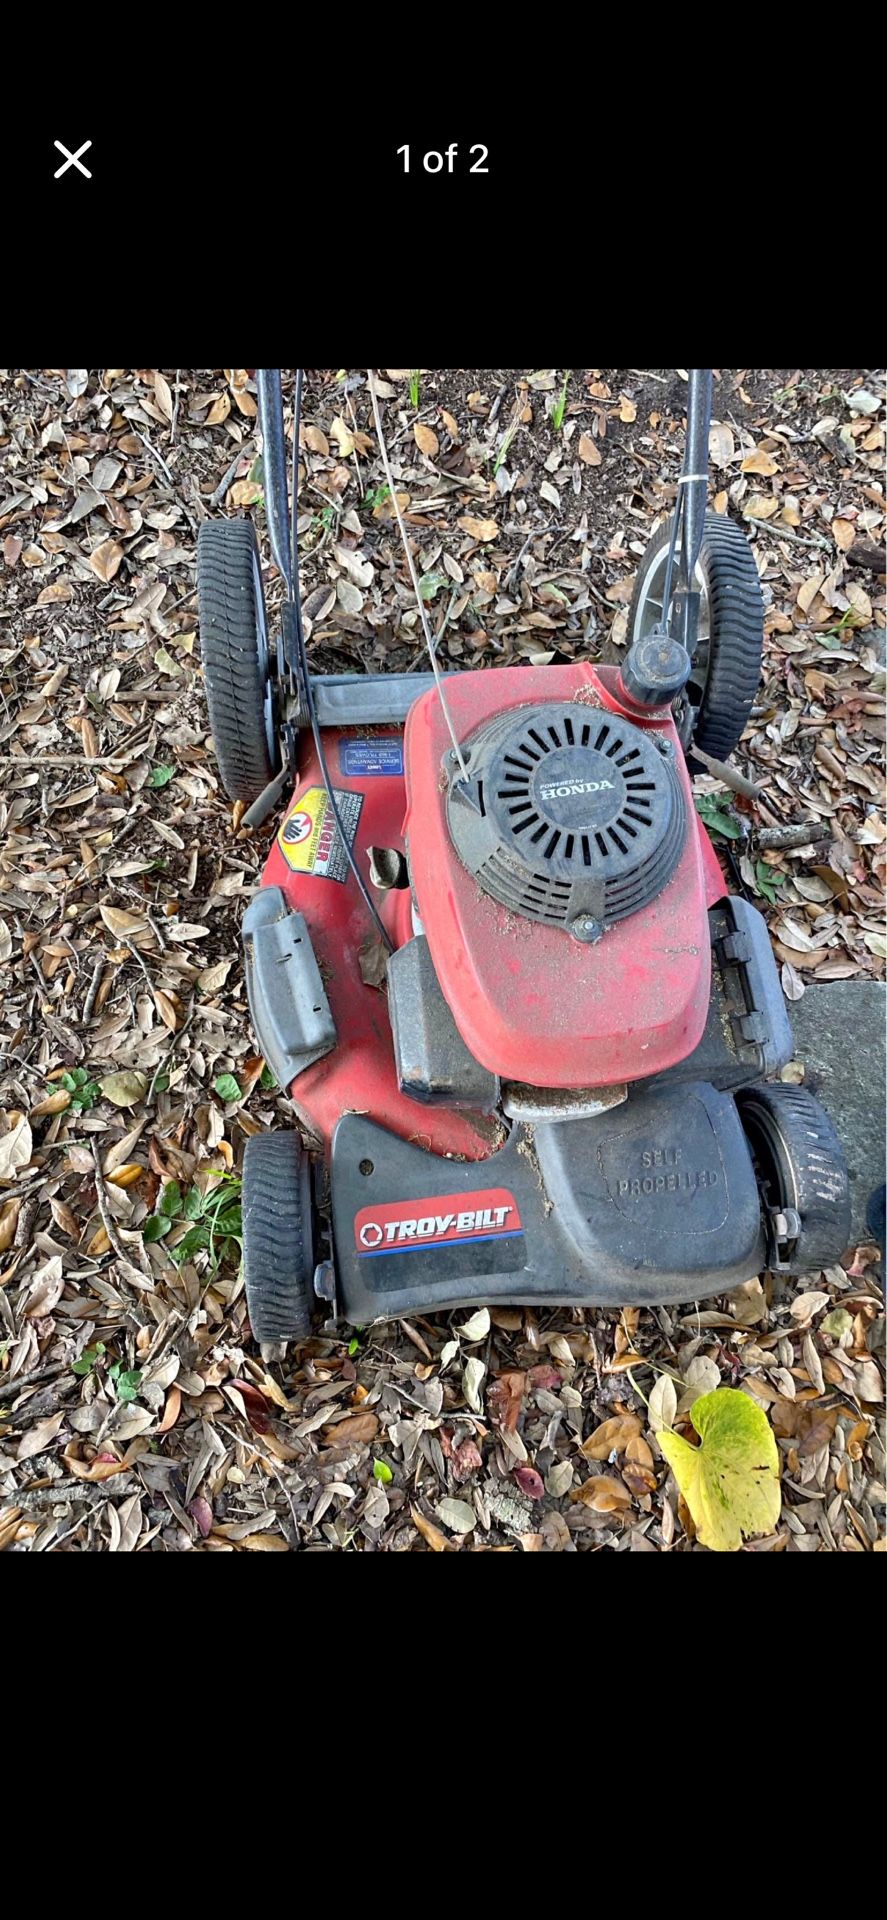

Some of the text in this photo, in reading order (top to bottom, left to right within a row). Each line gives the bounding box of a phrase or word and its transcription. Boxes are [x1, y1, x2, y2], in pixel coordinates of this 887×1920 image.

[539, 779, 575, 790] POWERED
[539, 780, 616, 801] HONDA
[319, 793, 327, 809] KEEP
[315, 809, 325, 828] HANDS
[310, 837, 318, 851] FEET
[306, 852, 315, 868] AWAY
[641, 1148, 682, 1169] SELF
[616, 1170, 718, 1197] PROPELLED
[383, 1205, 511, 1242] TROY-BILT
